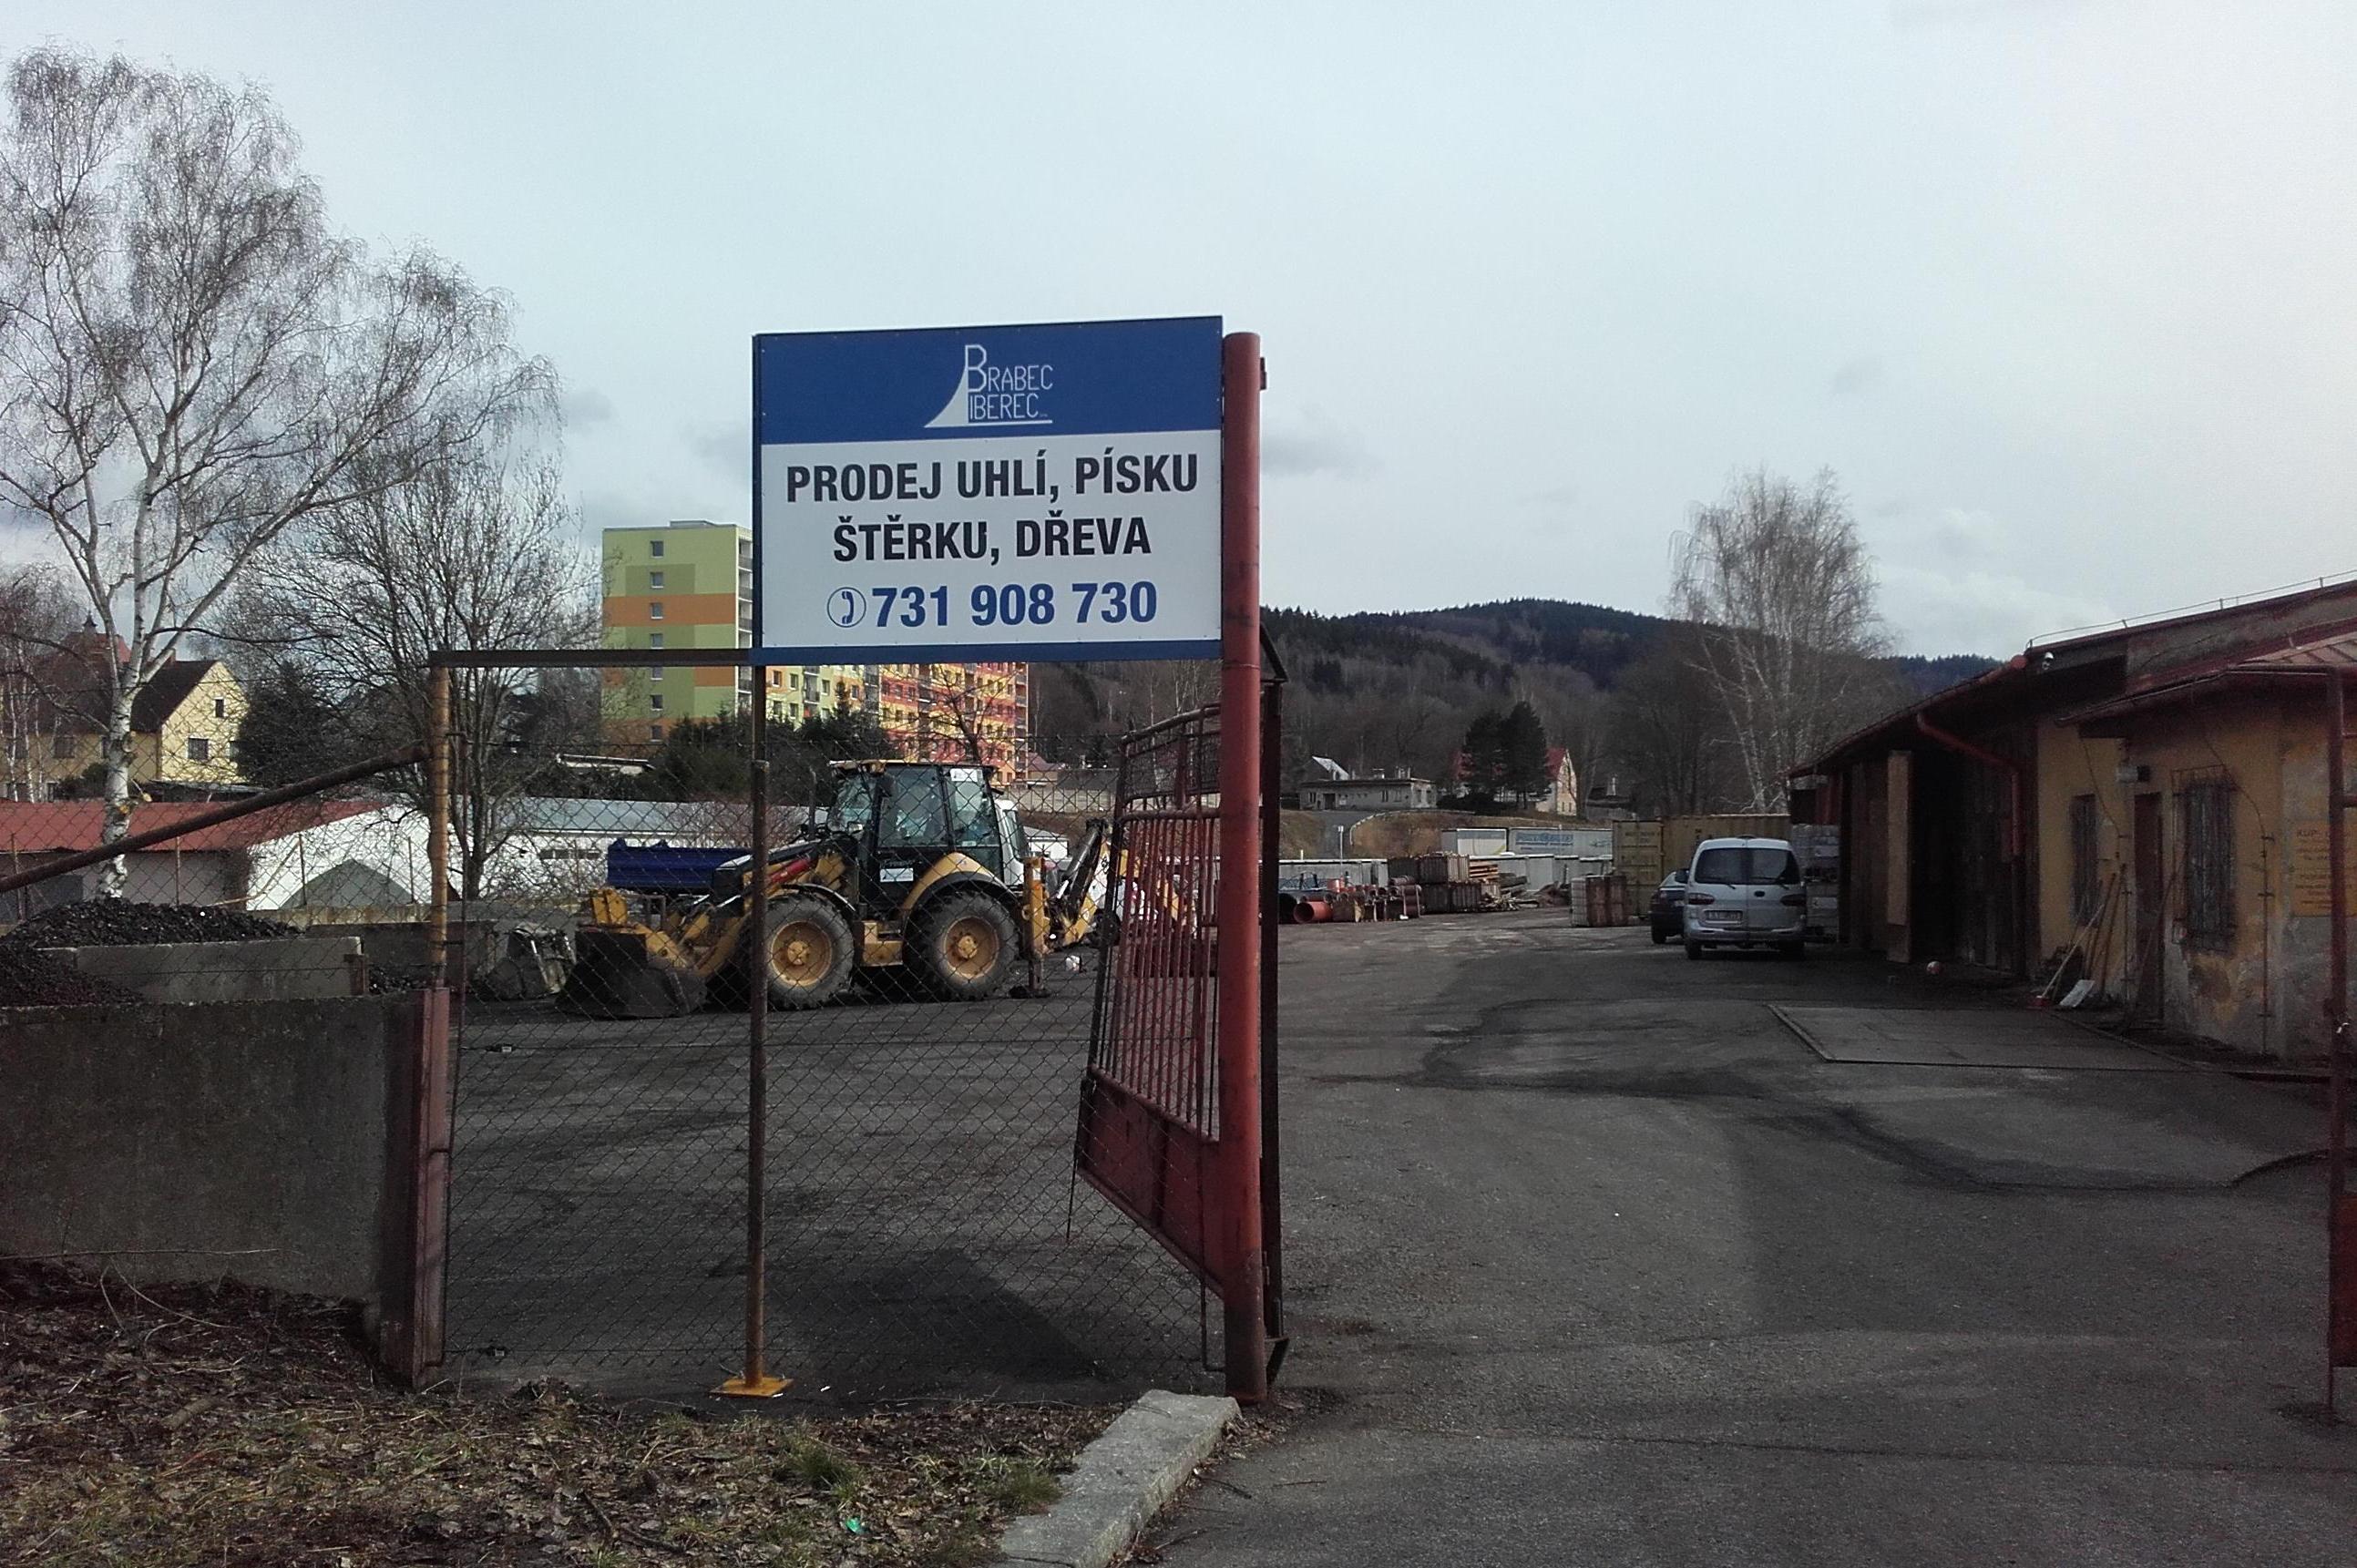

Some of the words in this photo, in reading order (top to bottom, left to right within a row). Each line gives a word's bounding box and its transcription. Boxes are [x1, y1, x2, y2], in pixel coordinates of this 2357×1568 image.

[964, 343, 1053, 393] BRABEC
[786, 461, 941, 503] PRODEJ
[958, 448, 1059, 504] UHLÍ,
[1075, 446, 1198, 495] PÍSKU
[834, 514, 999, 567] ŠTĚRKU,
[1016, 509, 1153, 558] DŘEVA
[872, 586, 948, 628] 731
[971, 584, 1055, 627] 908
[1072, 581, 1157, 624] 730
